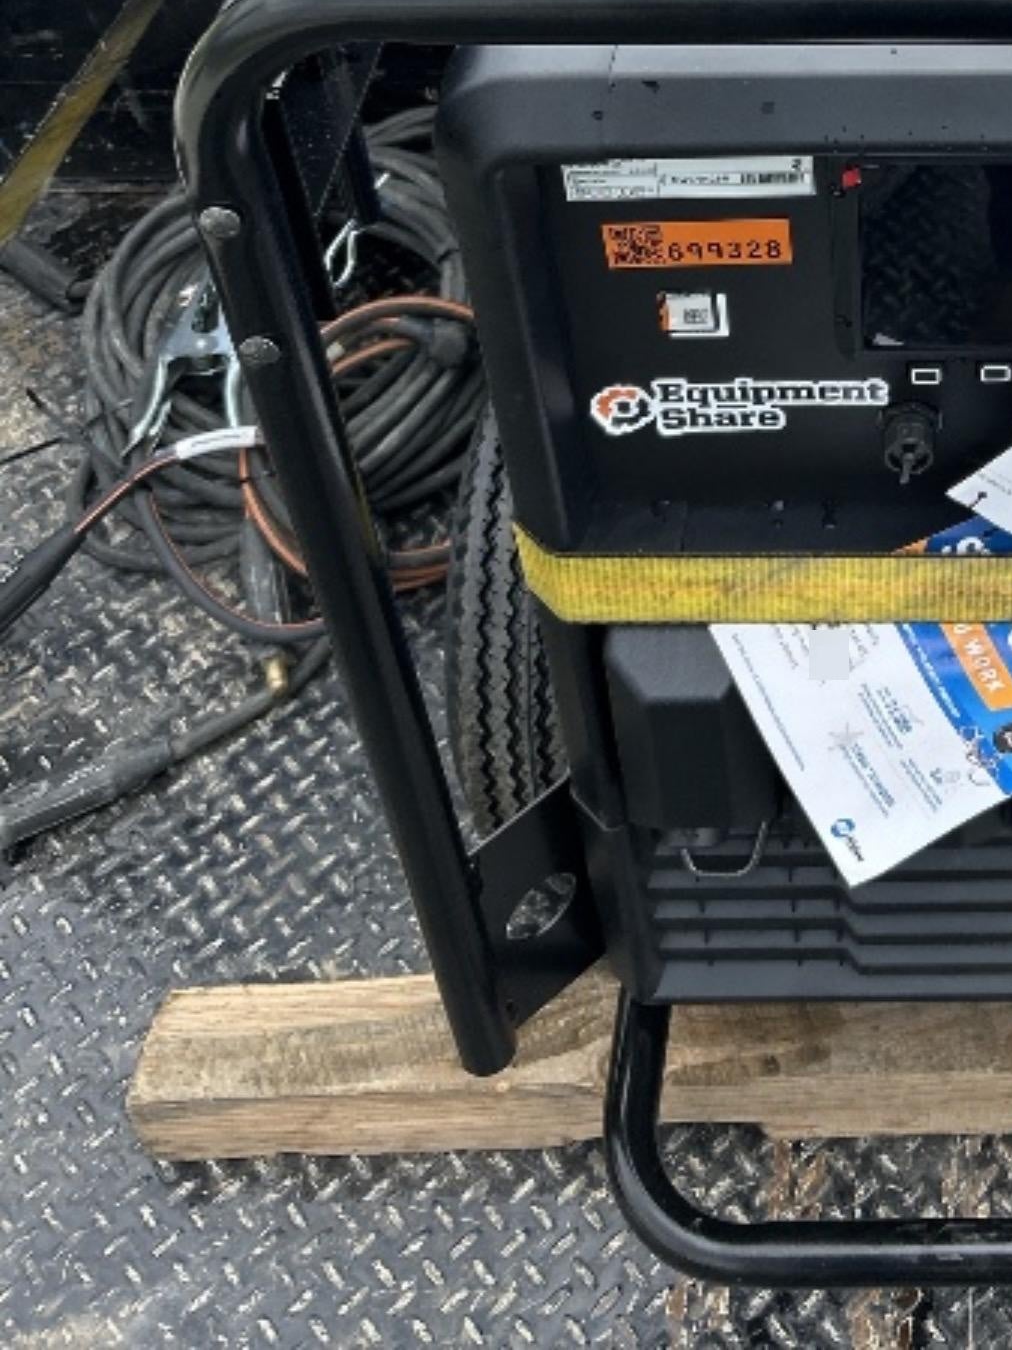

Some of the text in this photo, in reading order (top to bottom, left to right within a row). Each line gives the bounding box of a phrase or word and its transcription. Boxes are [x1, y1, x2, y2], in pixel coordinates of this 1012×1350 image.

[667, 239, 783, 262] 699328
[656, 379, 885, 407] Equipment
[660, 406, 784, 430] Share
